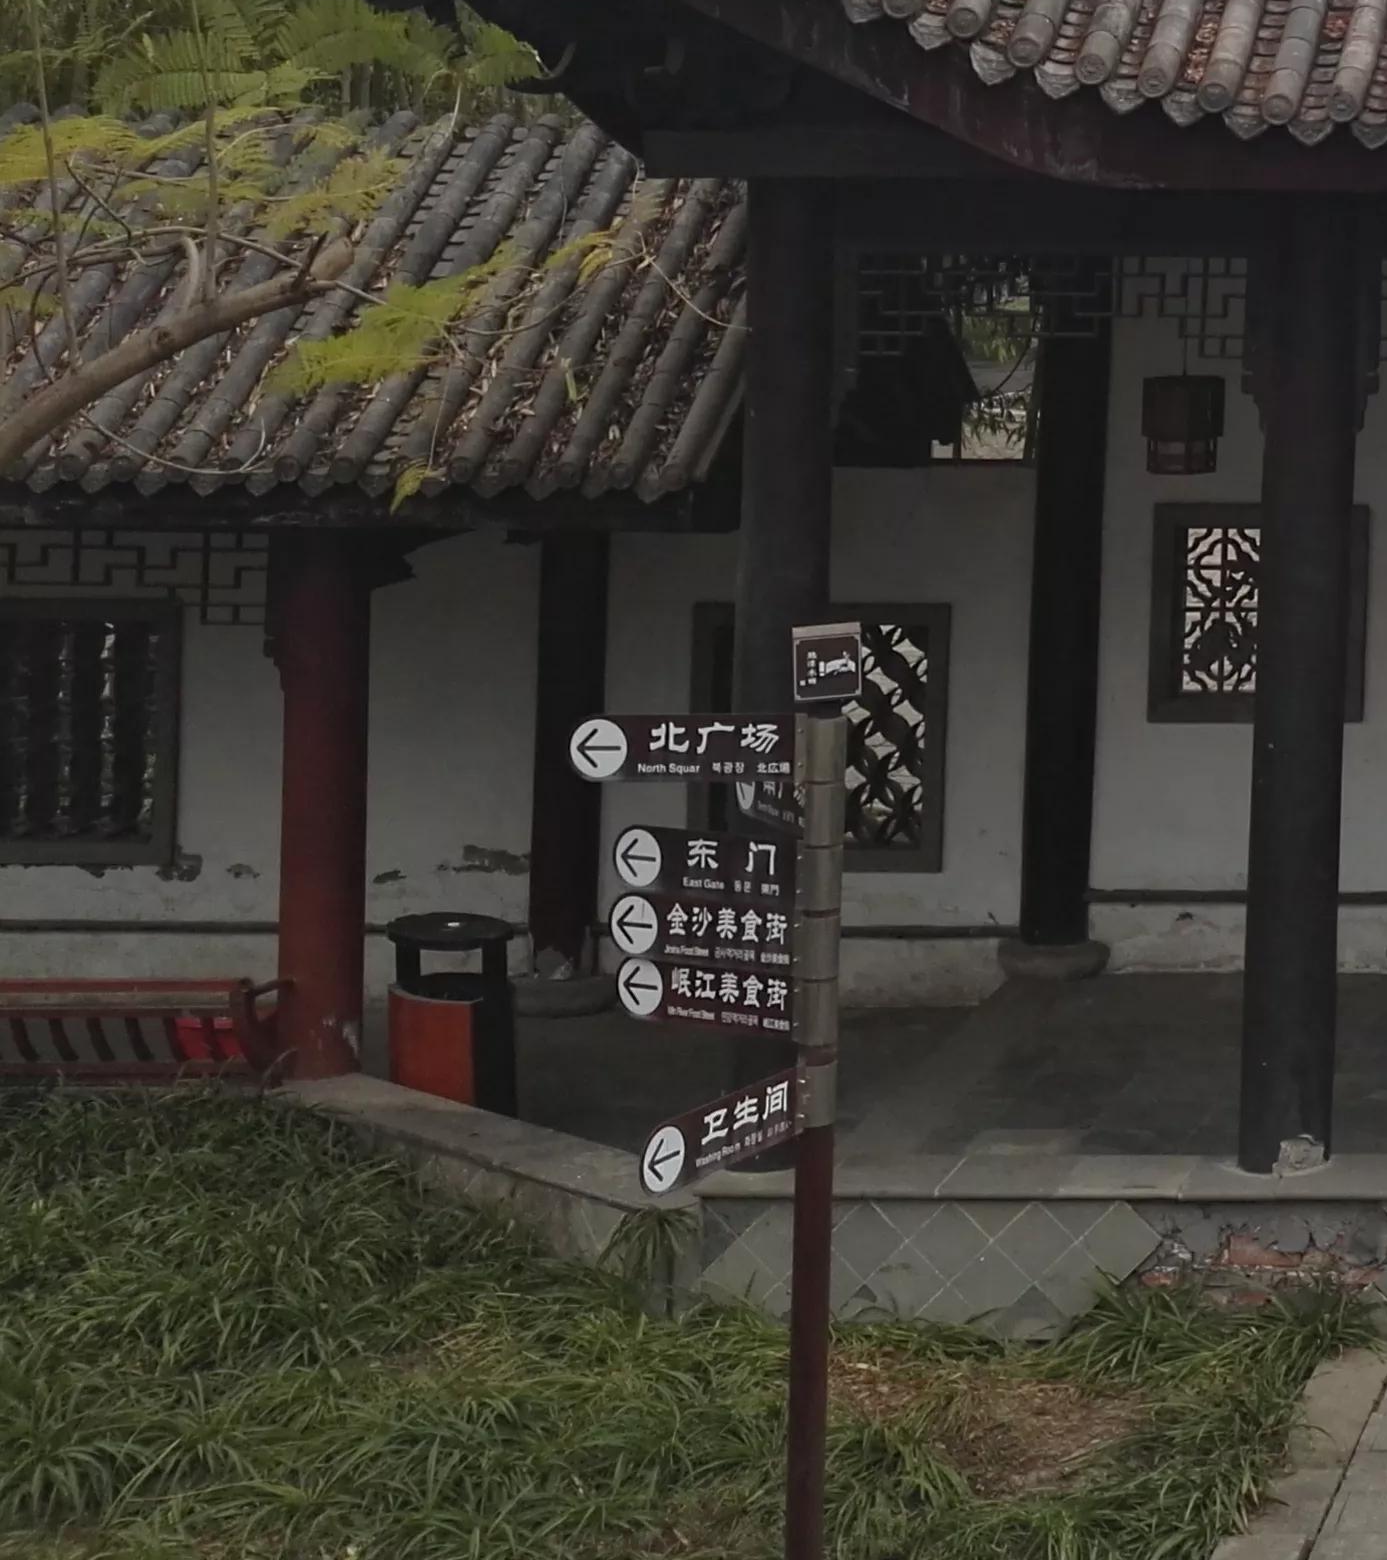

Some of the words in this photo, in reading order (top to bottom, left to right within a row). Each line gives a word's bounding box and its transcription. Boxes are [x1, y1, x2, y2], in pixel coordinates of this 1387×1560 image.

[649, 721, 780, 755] 北广场
[637, 762, 666, 773] North
[668, 762, 700, 775] Squar
[687, 838, 777, 876] 东门
[682, 876, 702, 888] East
[703, 878, 725, 890] Gate
[666, 902, 788, 945] 金沙美食街
[671, 966, 788, 1011] 岷江美食街
[701, 1080, 789, 1146] 卫生间
